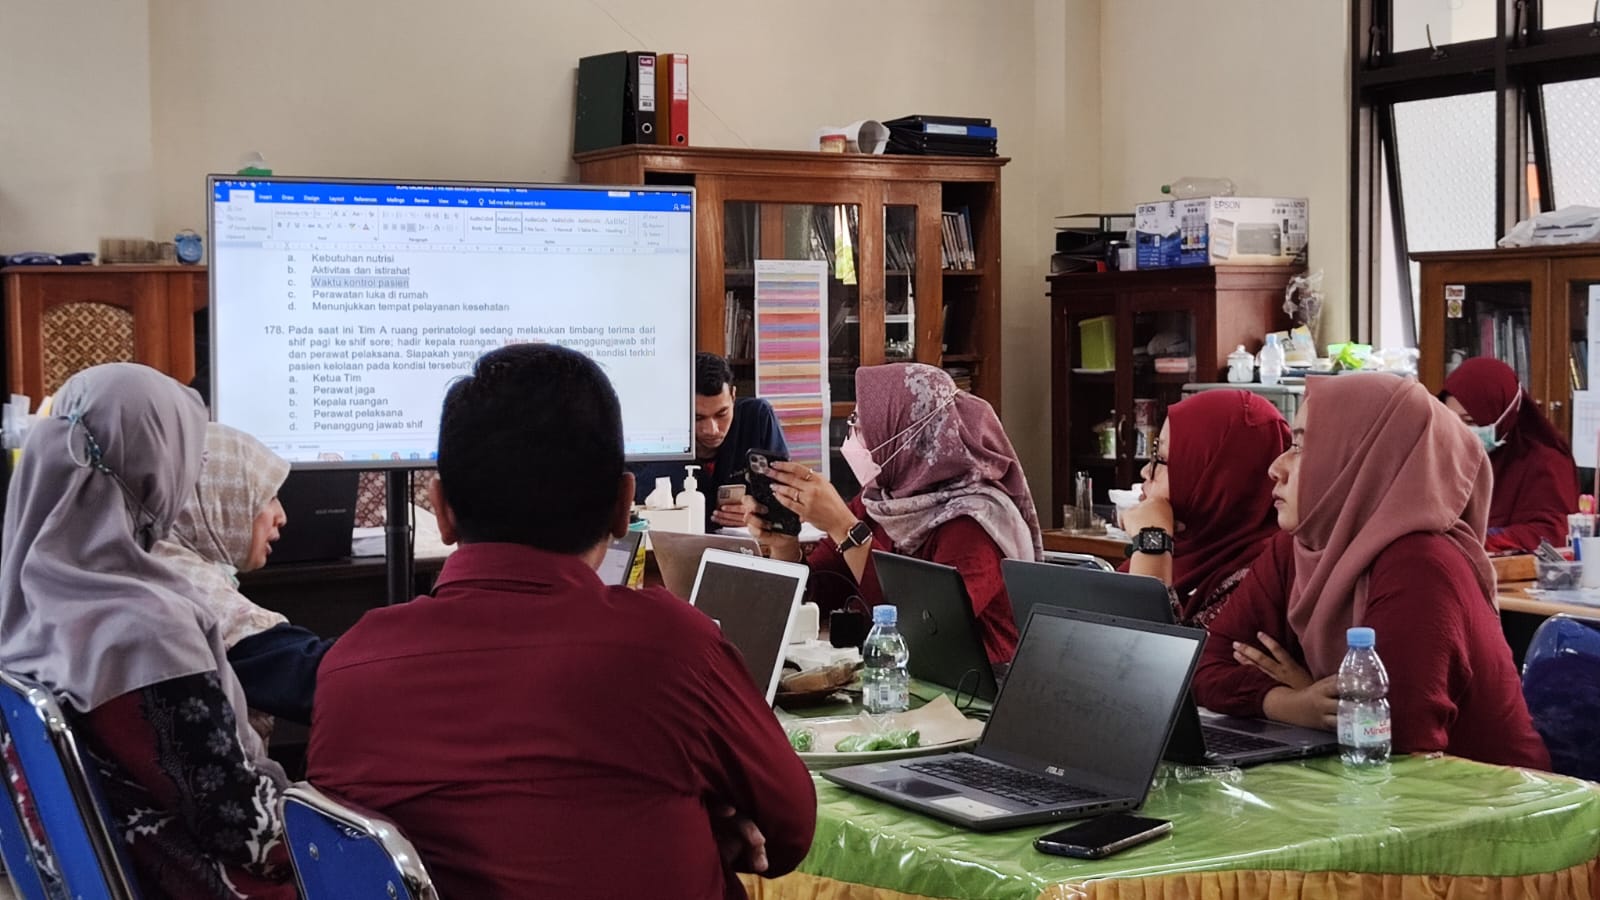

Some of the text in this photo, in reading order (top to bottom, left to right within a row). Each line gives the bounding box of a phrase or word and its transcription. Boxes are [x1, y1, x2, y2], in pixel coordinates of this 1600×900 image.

[329, 195, 345, 203] Layout
[1214, 201, 1241, 209] EPSON
[287, 254, 395, 263] a. Kebutuhan nutrisi
[287, 265, 411, 275] b. Aktivitas dan istirahat
[287, 278, 409, 289] c. Waktu kontrol pasien
[287, 289, 429, 299] c. Perawatan luka di rumah
[287, 302, 510, 314] d. Menunjukkan tempat pelayanan kesehatan
[264, 325, 285, 335] 178.
[288, 325, 314, 335] Pada
[318, 326, 339, 335] saat
[342, 326, 354, 335] ini
[379, 326, 388, 334] A
[391, 327, 418, 336] ruang
[422, 325, 476, 336] perinatologi
[479, 326, 514, 336] sedang
[516, 325, 566, 335] melakukan
[569, 325, 605, 336] timbang
[608, 325, 636, 335] terima
[638, 325, 656, 335] dari
[288, 337, 306, 347] shif
[310, 337, 331, 349] pagi
[335, 337, 346, 347] ke
[348, 337, 367, 347] shif
[397, 337, 422, 346] hadir
[424, 337, 456, 348] kepala
[556, 337, 637, 348] penanggungjawab
[640, 336, 656, 345] shif
[288, 349, 307, 359] dan
[310, 350, 349, 361] perawat
[405, 348, 450, 360] Siapakah
[452, 350, 476, 361] yang
[596, 347, 627, 357] kondisi
[629, 347, 656, 357] terkini
[288, 361, 321, 373] pasien
[323, 361, 364, 371] kelolaan
[366, 361, 390, 372] pada
[392, 361, 426, 370] kondisi
[313, 373, 341, 383] Ketua
[344, 373, 362, 382] Tim
[288, 385, 376, 396] a. Perawat jaga
[288, 398, 389, 408] b. Kepala ruangan
[288, 409, 403, 420] c. Perawat pelaksana
[288, 420, 423, 432] d. Penanggung jawab shif
